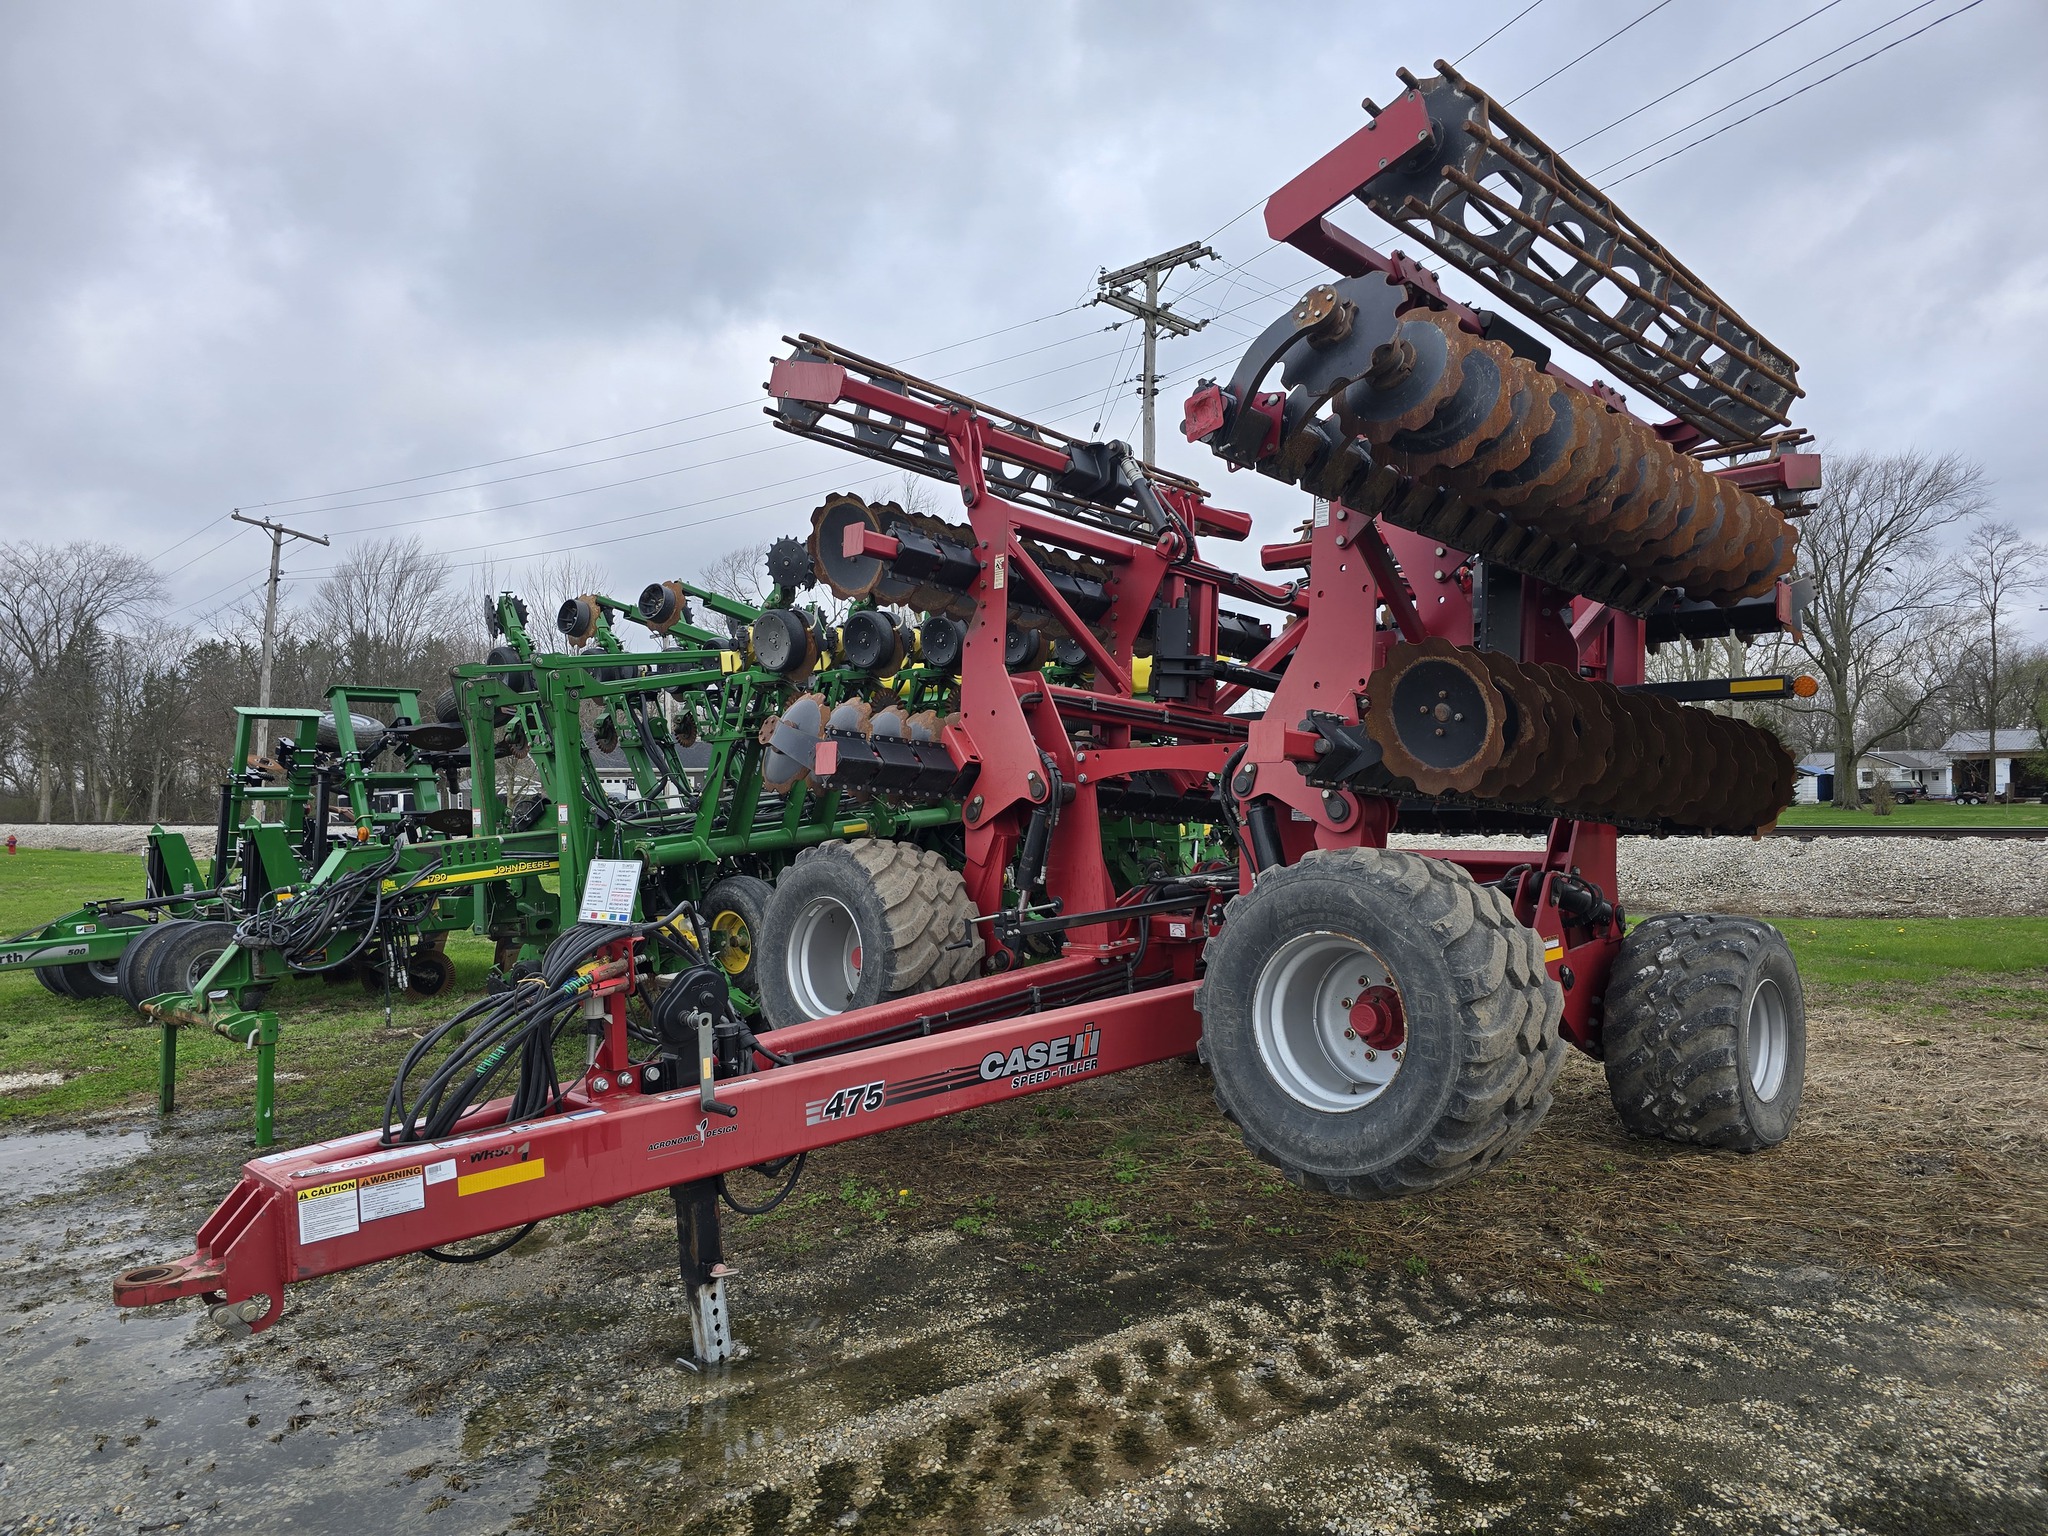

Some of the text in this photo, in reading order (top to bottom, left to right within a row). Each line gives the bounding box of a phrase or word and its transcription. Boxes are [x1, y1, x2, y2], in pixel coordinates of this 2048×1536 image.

[494, 860, 550, 874] JOHN DEERE
[427, 873, 447, 883] 1790
[67, 948, 86, 956] 500
[980, 1035, 1071, 1081] CASE
[822, 1080, 886, 1121] 475
[647, 1123, 738, 1152] AGRONOMIC DESIGN
[370, 1166, 421, 1184] WARNING
[311, 1181, 355, 1198] CAUTION
